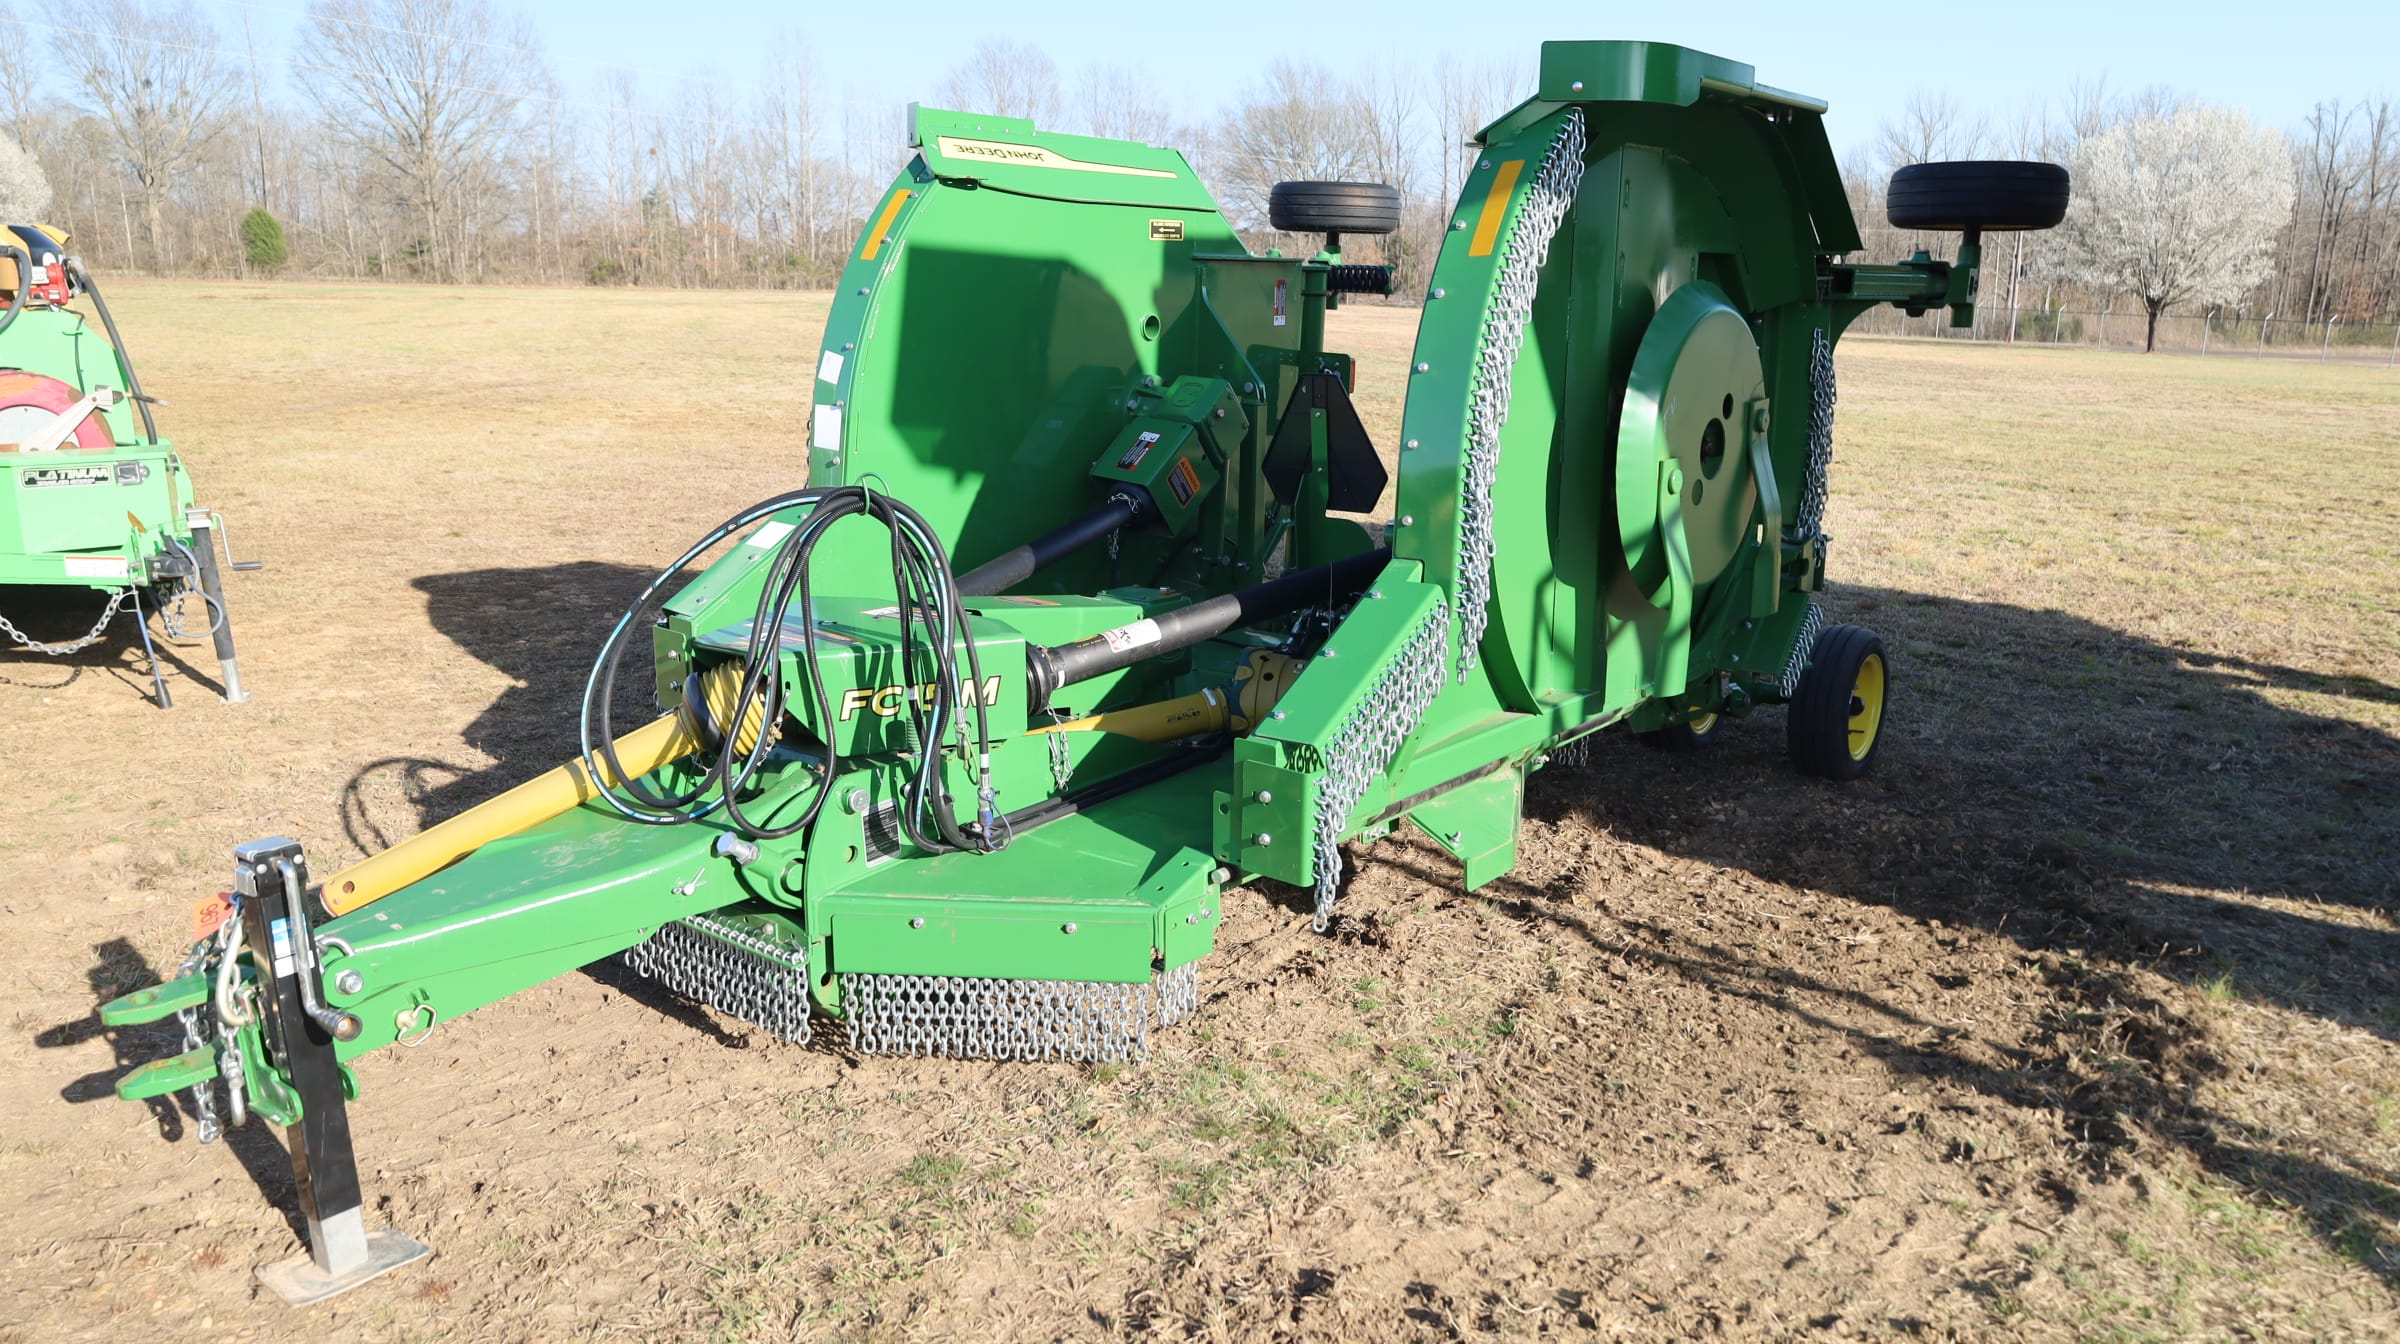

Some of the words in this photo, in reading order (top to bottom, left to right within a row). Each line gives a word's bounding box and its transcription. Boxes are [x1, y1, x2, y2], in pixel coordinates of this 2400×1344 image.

[953, 144, 1007, 159] DEERE
[1006, 150, 1045, 162] JOHN
[24, 467, 109, 482] PLATINUM
